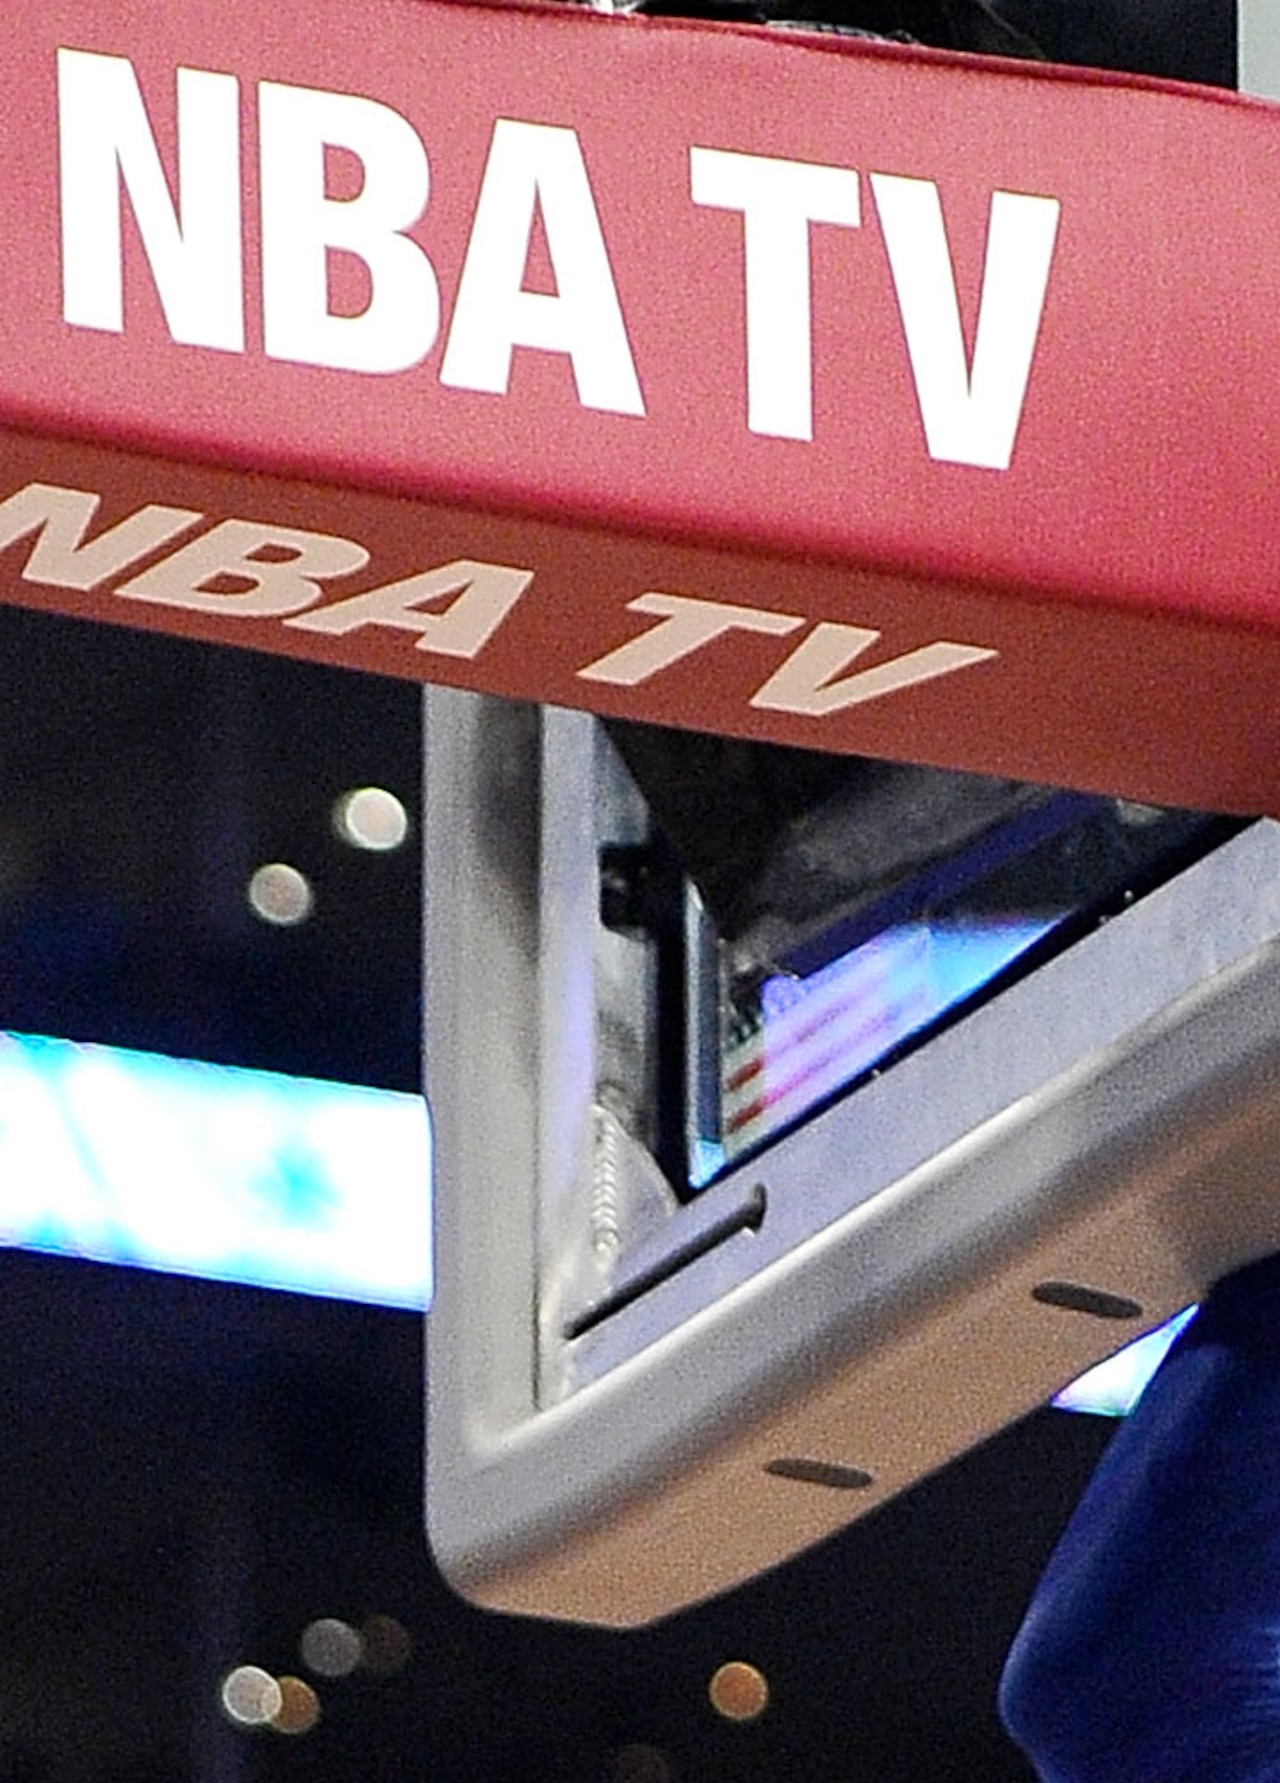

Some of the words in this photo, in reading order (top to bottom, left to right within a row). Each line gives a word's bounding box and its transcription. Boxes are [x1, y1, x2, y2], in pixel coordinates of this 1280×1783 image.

[56, 46, 648, 418] NBA
[689, 143, 1062, 472] TV
[0, 481, 535, 660] NBA
[577, 592, 999, 718] TV
